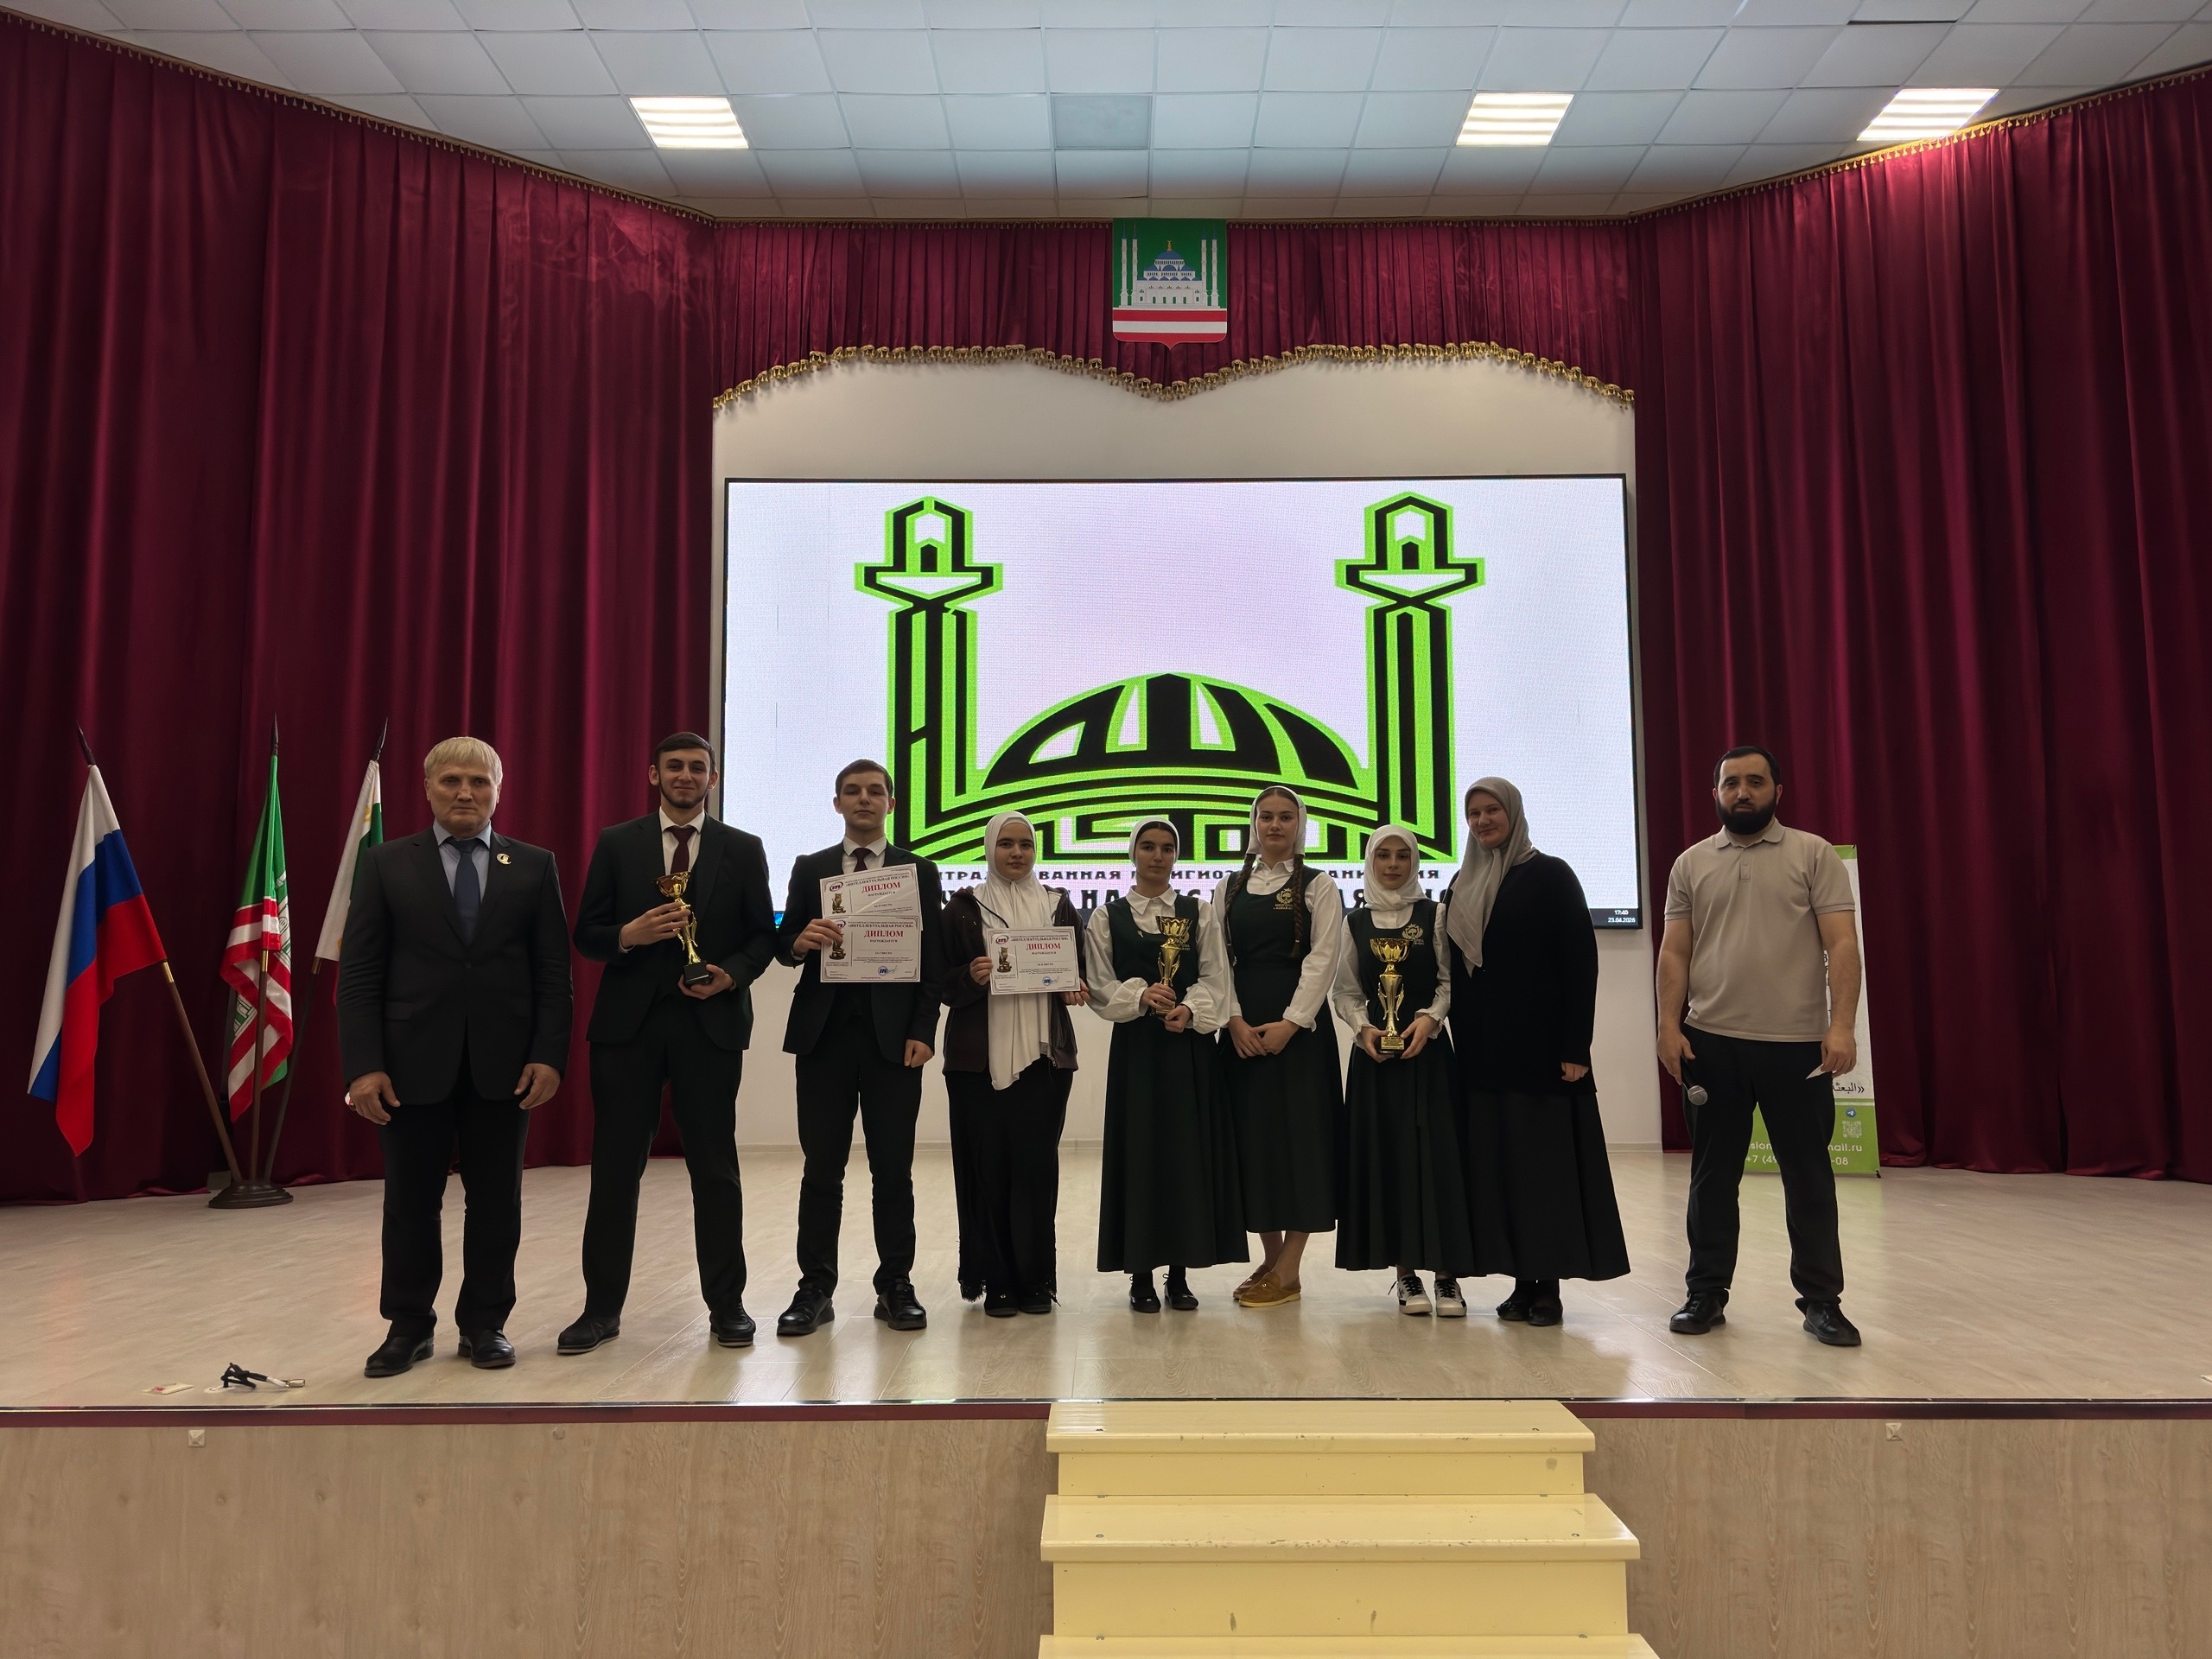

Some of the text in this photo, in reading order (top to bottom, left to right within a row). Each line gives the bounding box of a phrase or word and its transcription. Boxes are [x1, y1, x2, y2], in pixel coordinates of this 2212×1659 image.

[861, 881, 900, 893] ДИПЛОМ
[1745, 1154, 1758, 1163] +7
[1831, 1156, 1848, 1166] -08
